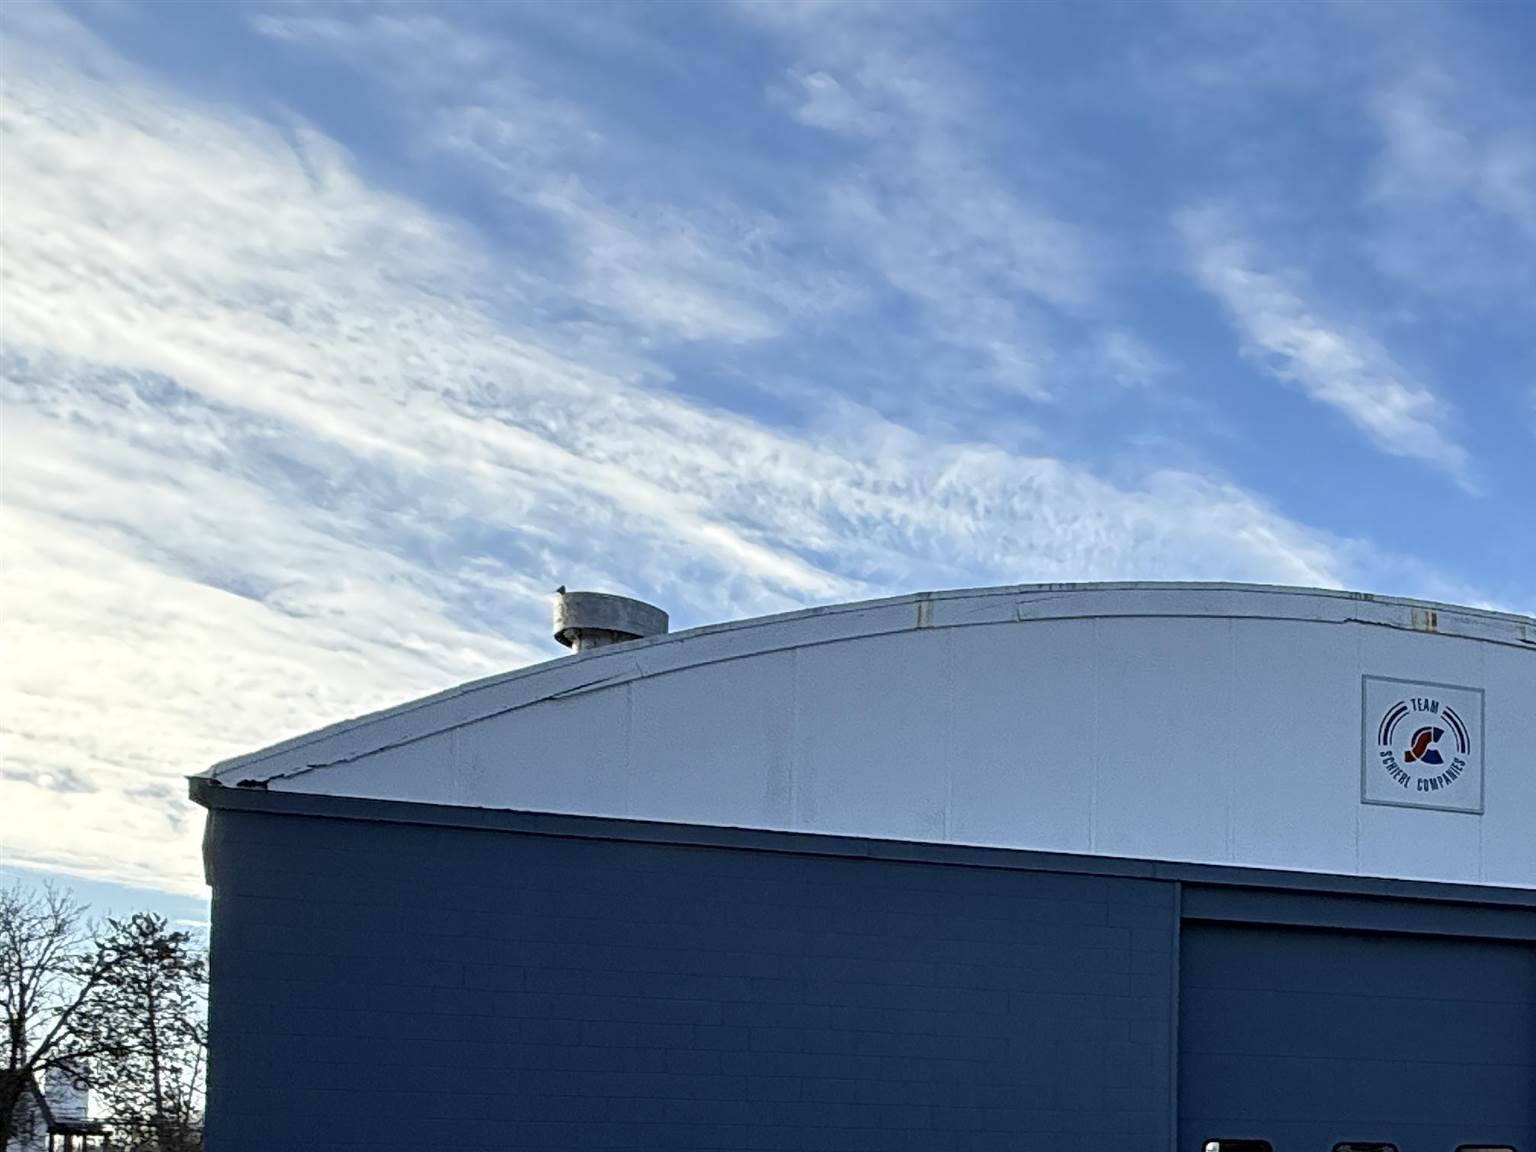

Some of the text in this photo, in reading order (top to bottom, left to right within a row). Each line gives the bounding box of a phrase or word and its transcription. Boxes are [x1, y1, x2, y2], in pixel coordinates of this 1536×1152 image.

[1410, 698, 1439, 714] TEAM
[1380, 750, 1466, 792] SCHIERL COMPANIES
